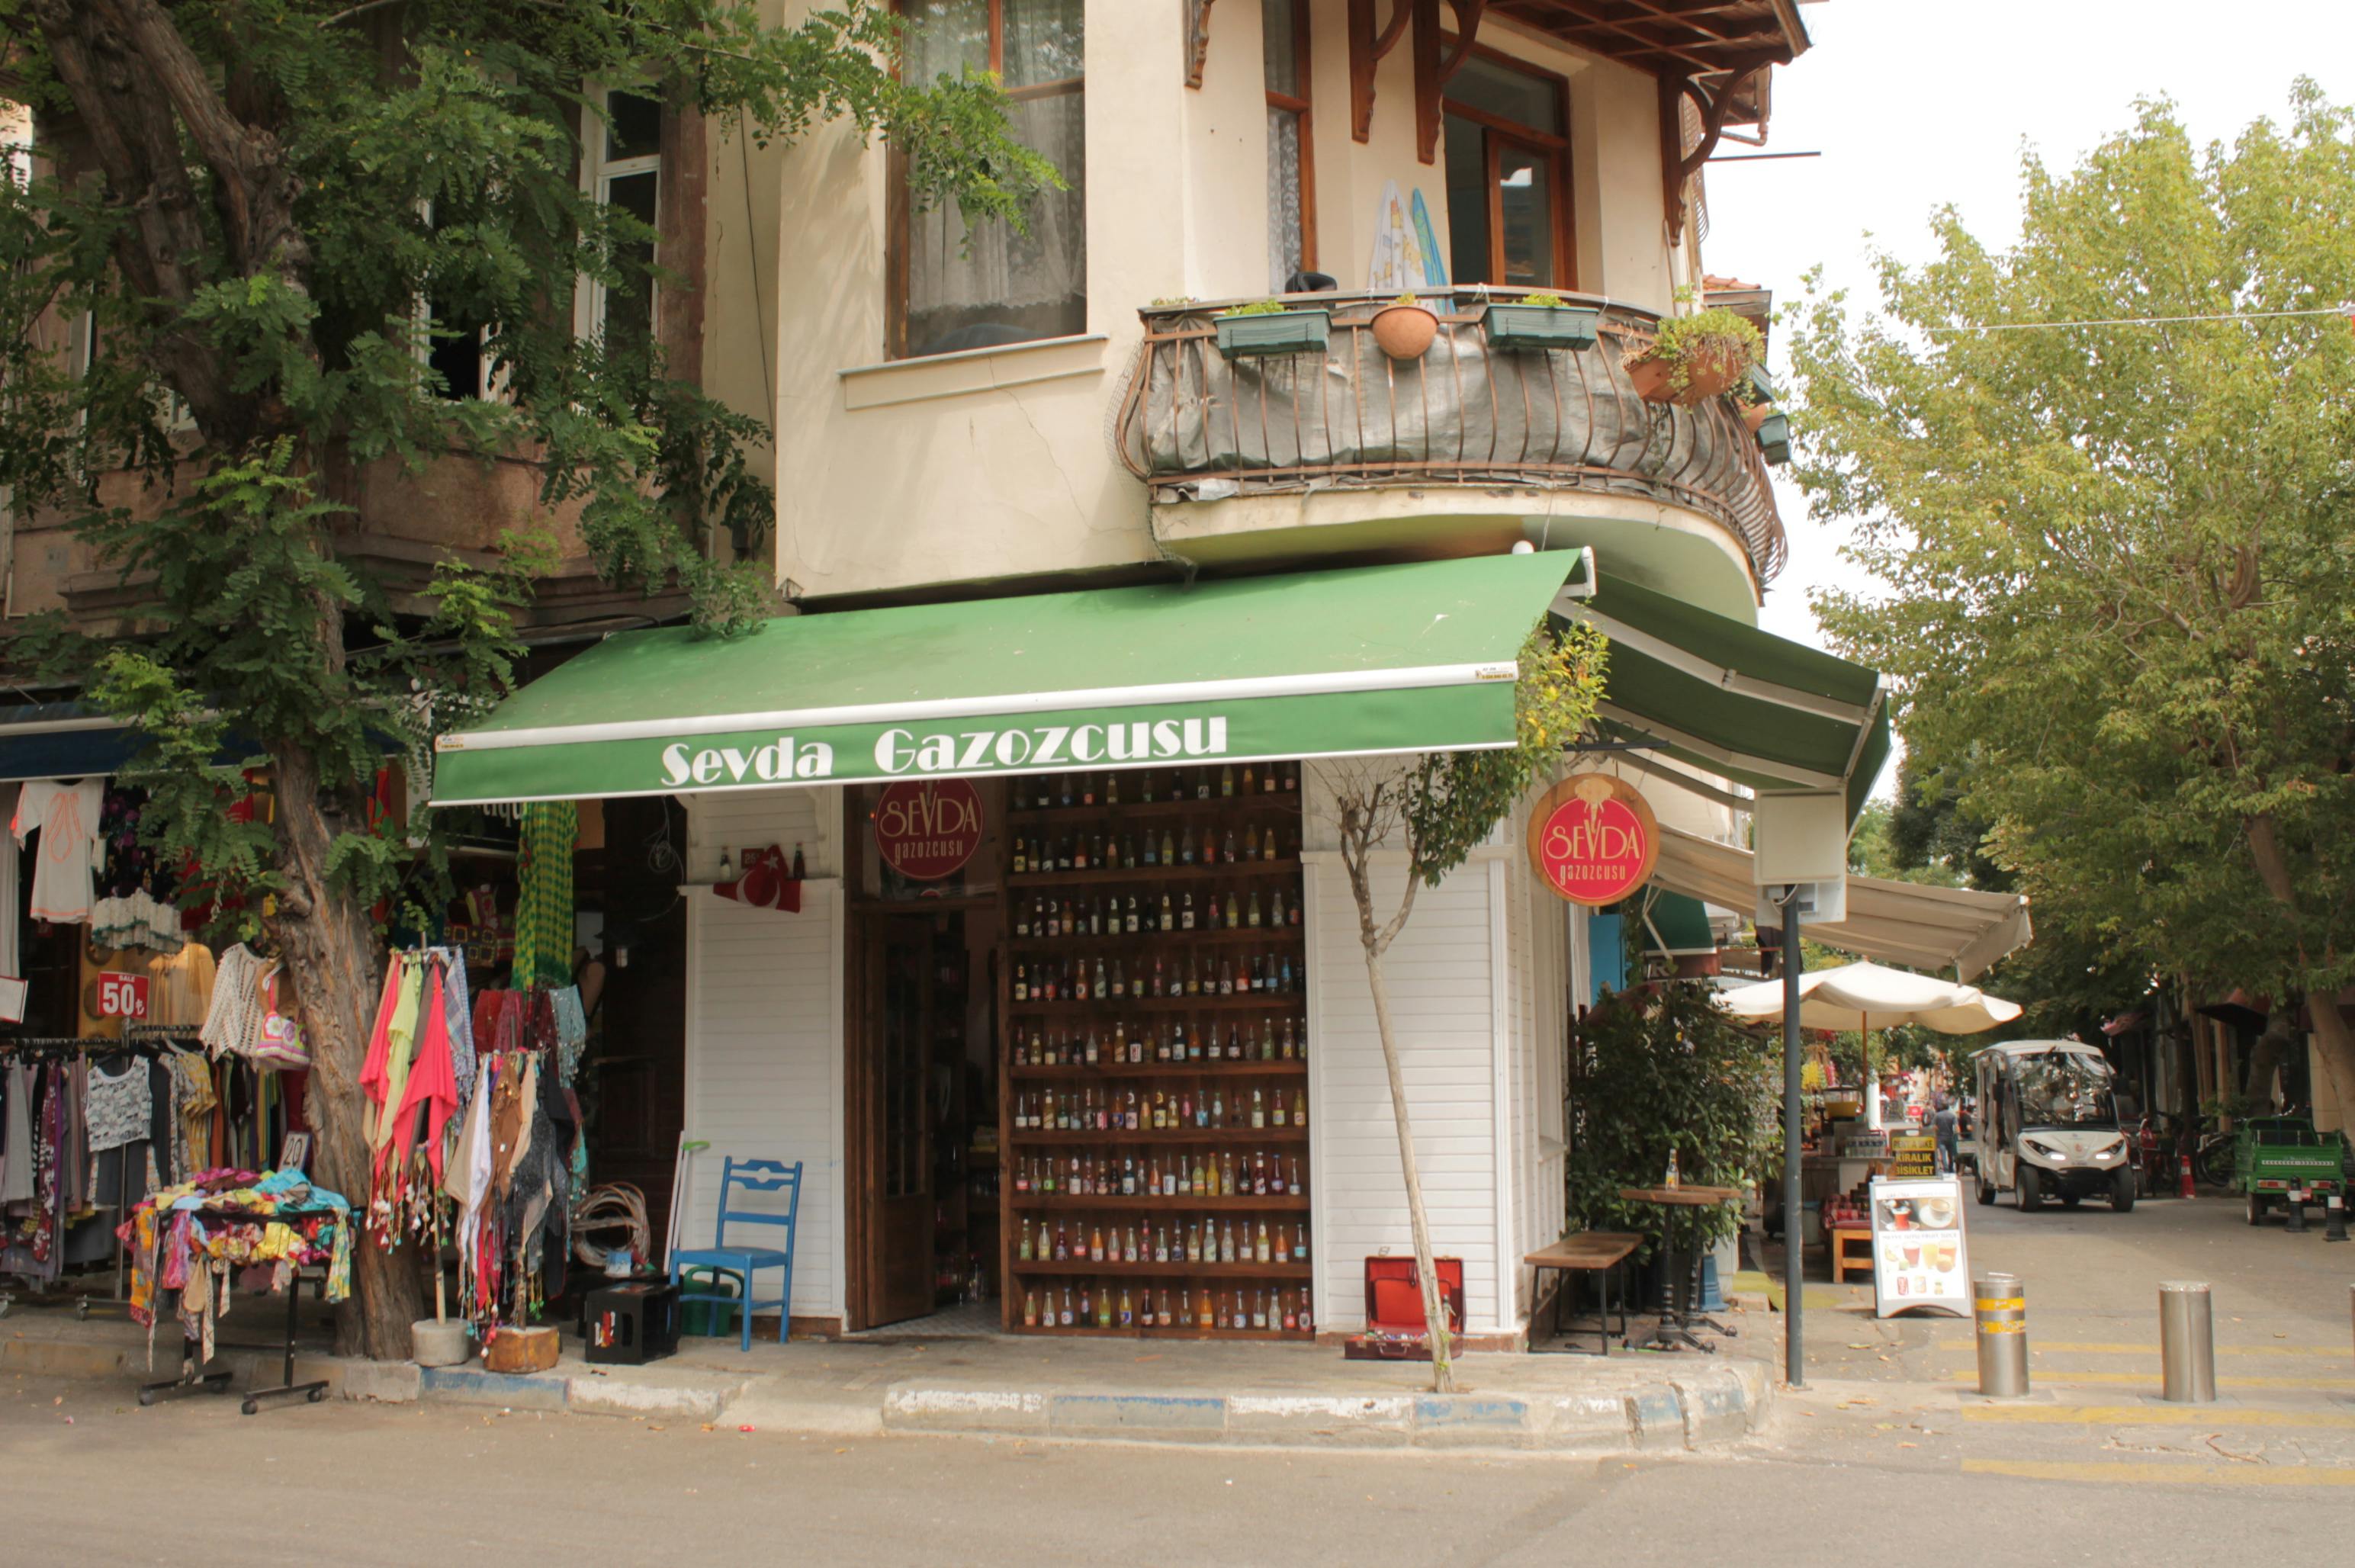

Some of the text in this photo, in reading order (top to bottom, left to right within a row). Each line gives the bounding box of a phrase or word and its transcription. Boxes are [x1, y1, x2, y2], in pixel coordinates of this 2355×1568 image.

[660, 716, 1227, 787] Sevda Gazozcusu
[879, 791, 978, 837] SEVDA
[895, 840, 963, 866] gazozcusu
[1545, 818, 1640, 862] SEVDA
[1560, 864, 1626, 886] gazozcusu
[118, 975, 135, 983] SALE
[282, 1137, 303, 1167] 20
